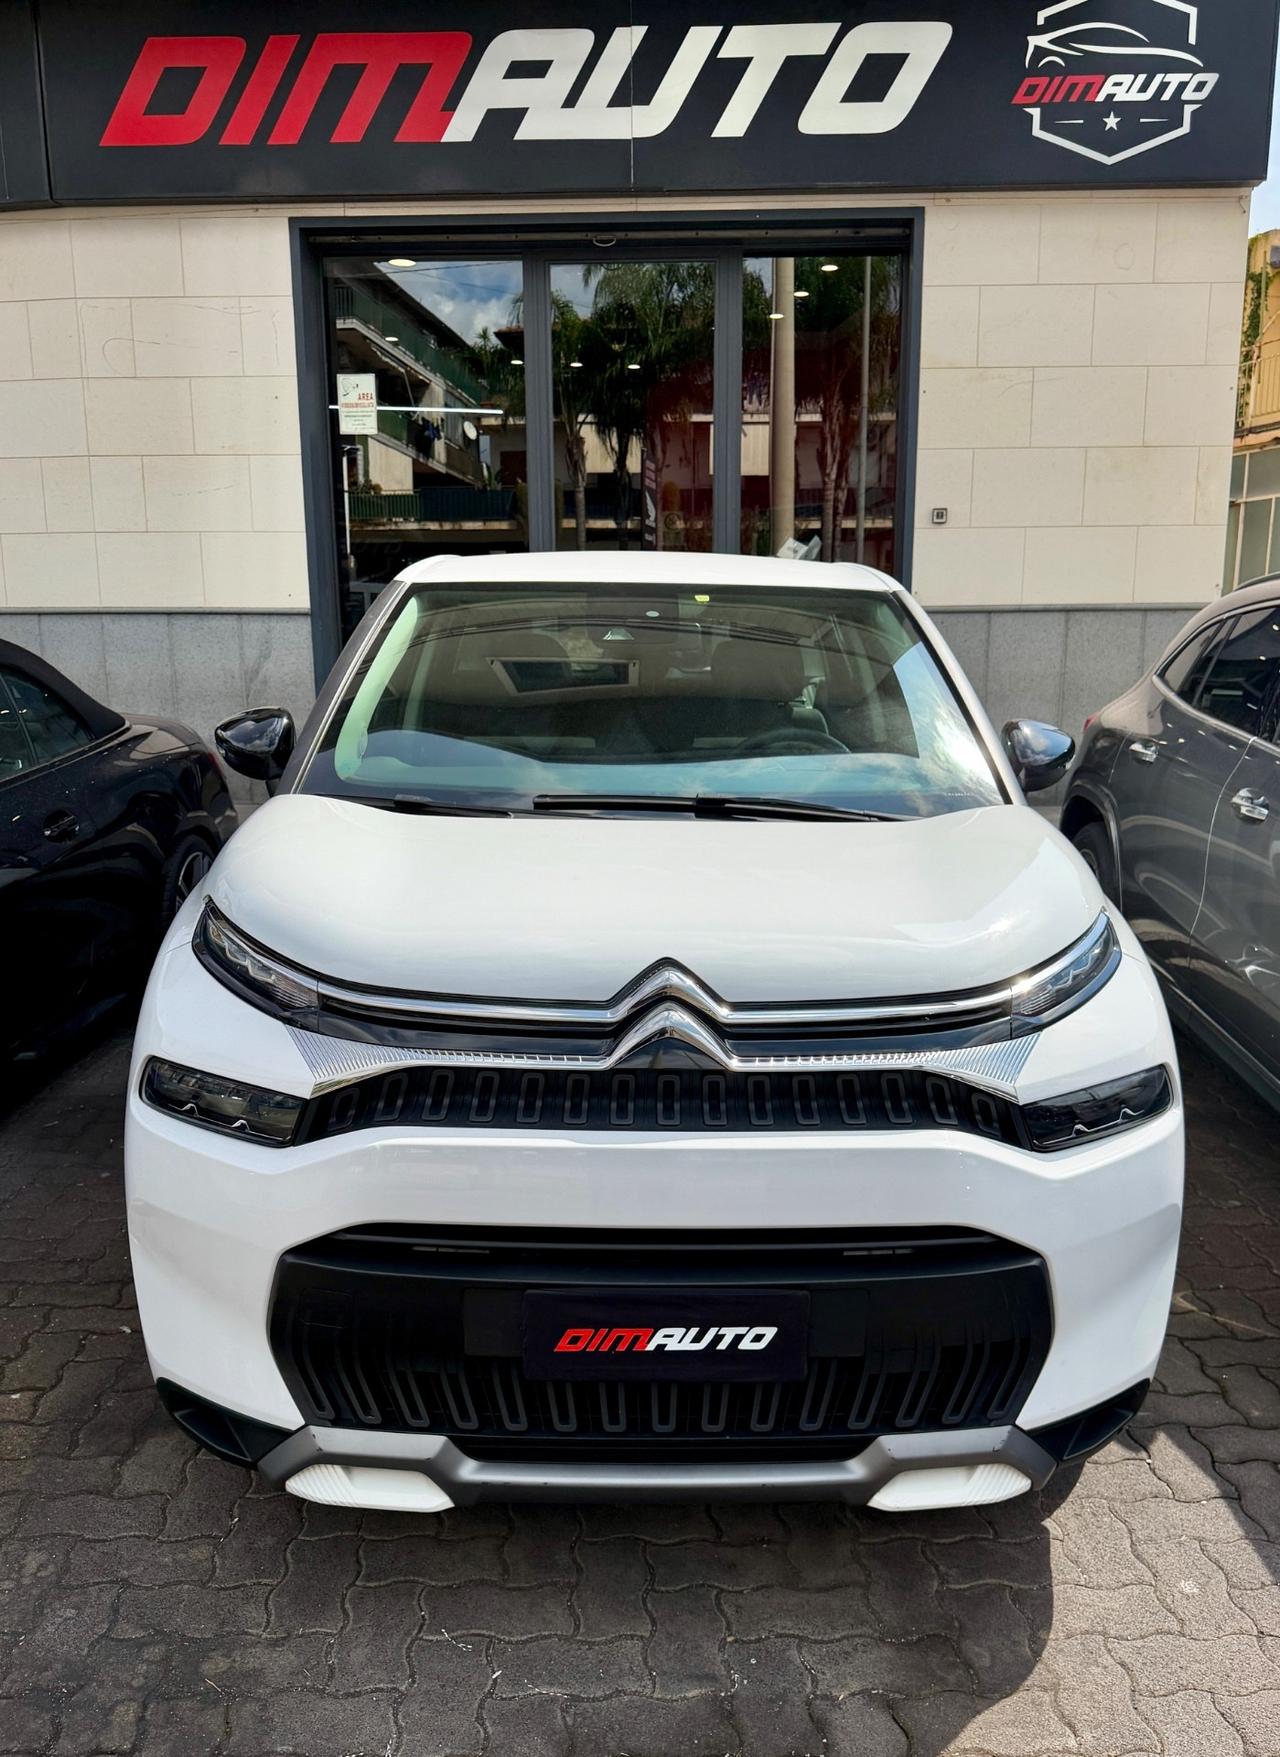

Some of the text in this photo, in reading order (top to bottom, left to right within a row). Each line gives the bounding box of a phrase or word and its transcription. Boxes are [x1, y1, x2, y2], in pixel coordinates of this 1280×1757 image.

[100, 21, 953, 147] DIMAUTO
[1012, 72, 1220, 104] DIMAUTO
[358, 392, 374, 401] AREA
[554, 1326, 778, 1352] DIMAUTO
